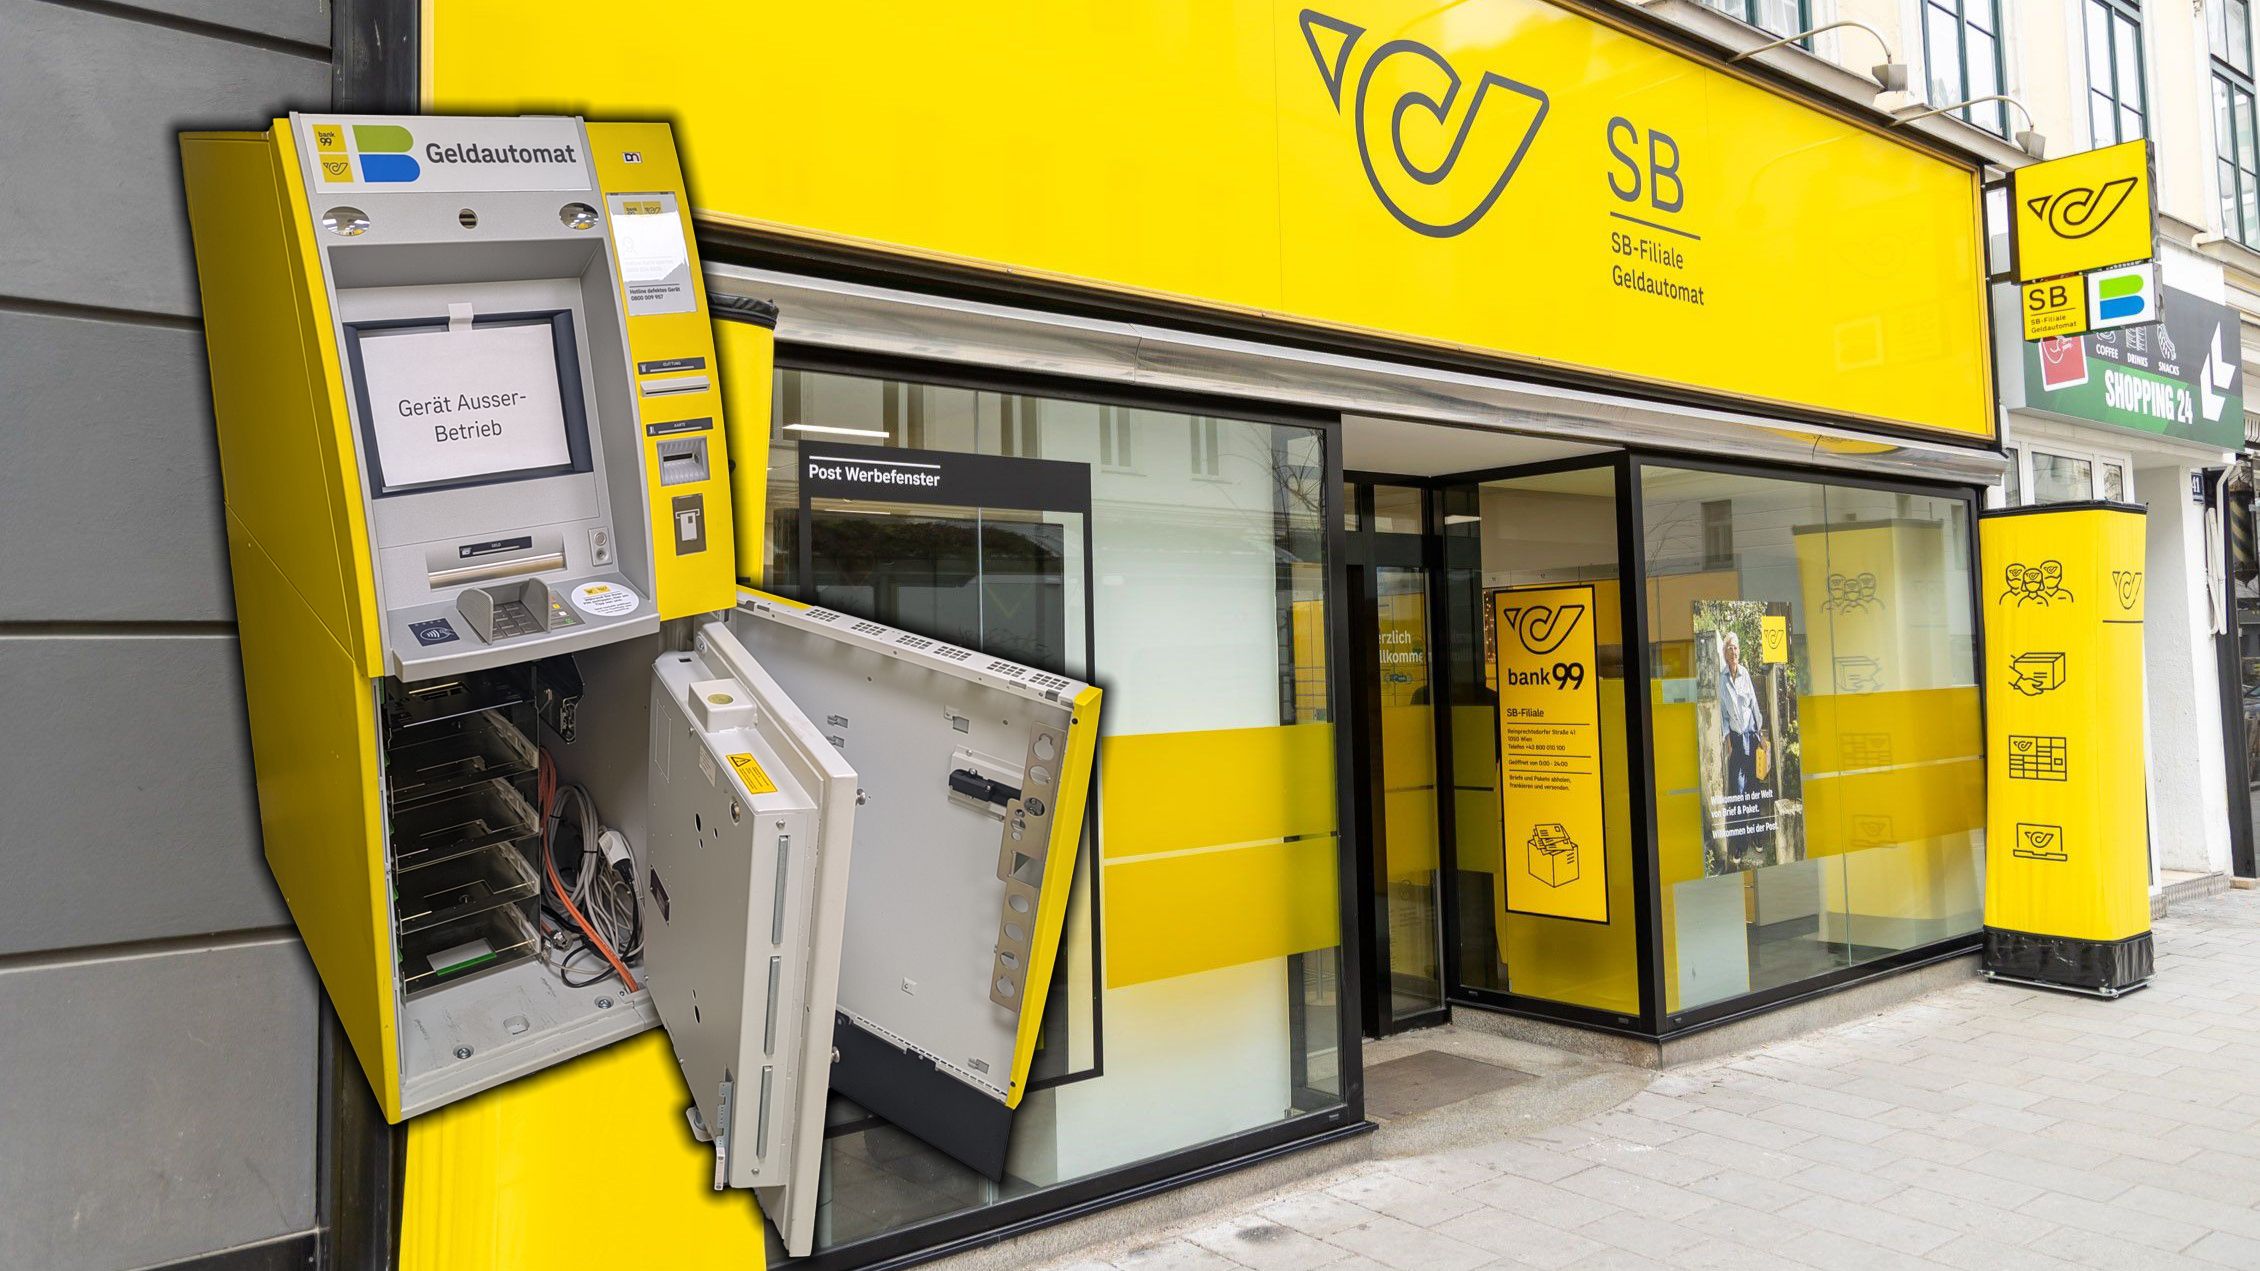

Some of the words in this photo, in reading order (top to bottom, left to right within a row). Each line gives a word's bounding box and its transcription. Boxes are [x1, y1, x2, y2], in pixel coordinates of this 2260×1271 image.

[320, 137, 332, 146] 99
[425, 142, 577, 164] Geldautomat
[1607, 116, 1684, 214] SB
[1611, 231, 1684, 270] SB-Filiale
[1612, 265, 1705, 306] Geldautomat
[2029, 285, 2068, 311] SB
[2031, 314, 2067, 326] SB-Filiale
[2031, 321, 2077, 334] Geldautomat
[2095, 343, 2119, 359] COFFEE
[2127, 352, 2148, 368] DRINKS
[2158, 361, 2180, 376] SNACKS
[398, 396, 452, 417] Gerät
[457, 392, 527, 412] Ausser-
[2105, 369, 2175, 421] SHOPPING
[2177, 388, 2193, 425] 24
[434, 419, 503, 443] Betrieb
[808, 463, 843, 481] Post
[844, 465, 941, 487] Werbefenster
[1506, 707, 1545, 718] SB-Filiale
[1711, 794, 1744, 805] Willkommen
[1744, 791, 1750, 800] in
[1751, 790, 1760, 800] der
[1760, 788, 1773, 799] Welt
[1722, 805, 1737, 817] Brief
[1737, 806, 1742, 815] &
[1742, 804, 1760, 814] Paket.
[1712, 827, 1746, 840] Willkommen
[1746, 823, 1755, 834] bei
[1755, 823, 1765, 833] der
